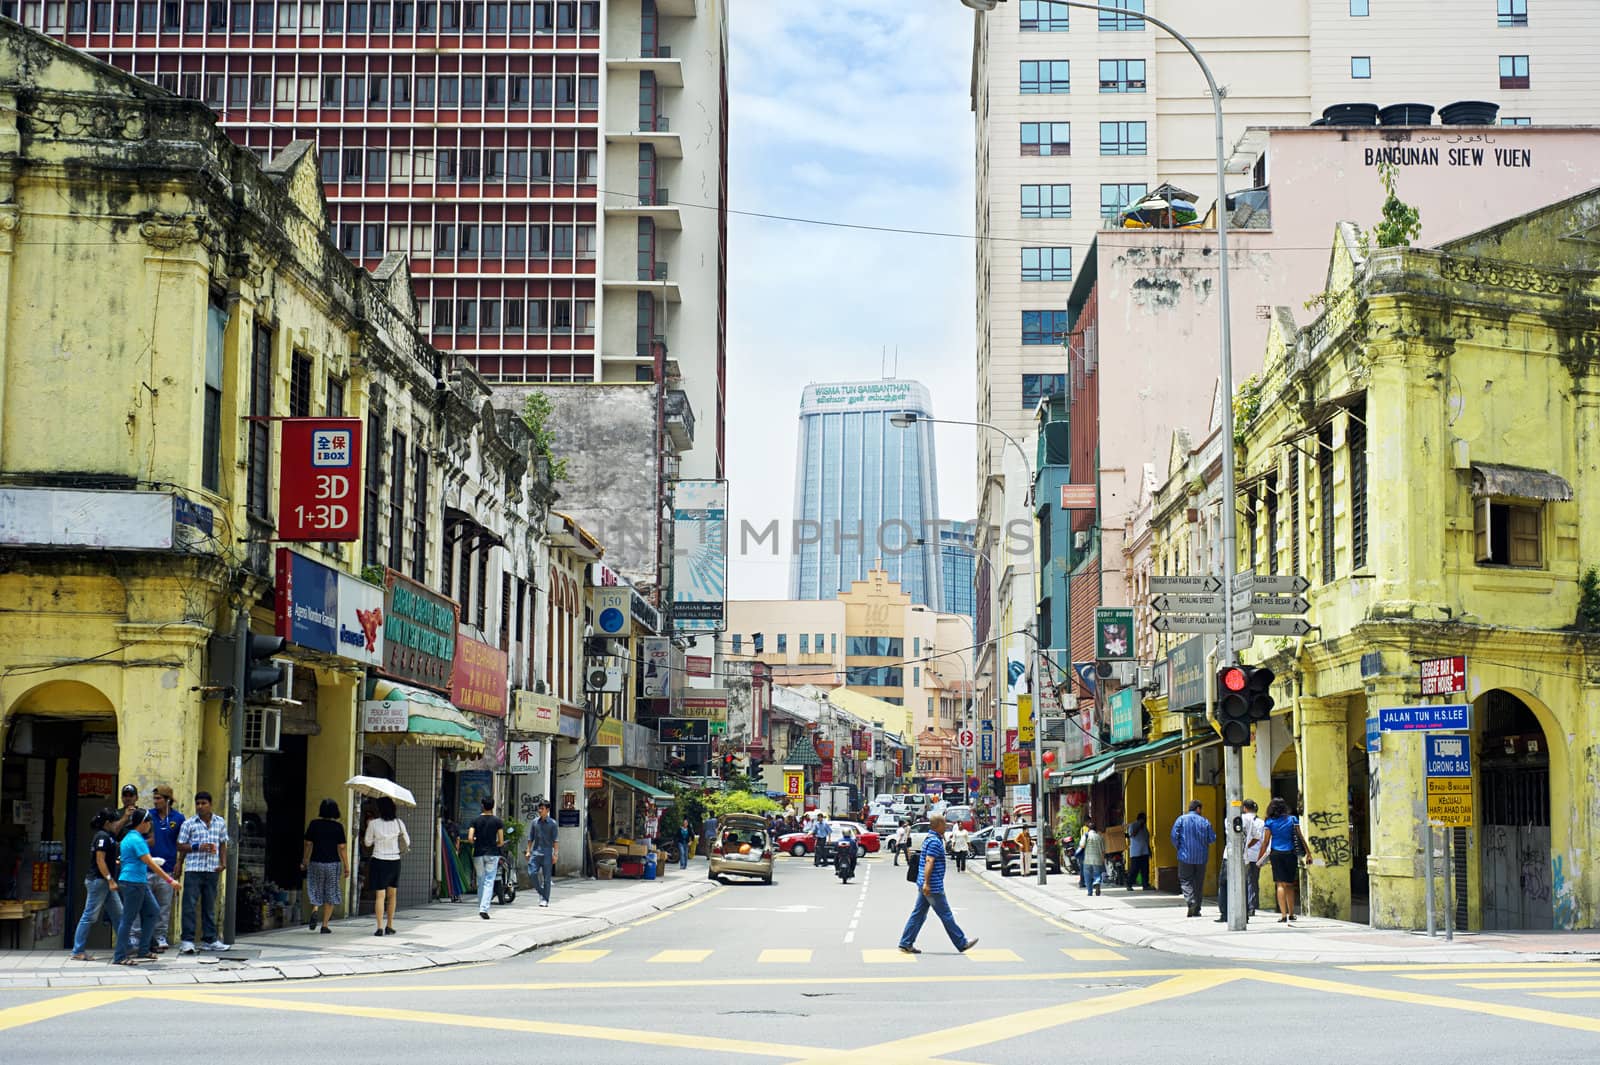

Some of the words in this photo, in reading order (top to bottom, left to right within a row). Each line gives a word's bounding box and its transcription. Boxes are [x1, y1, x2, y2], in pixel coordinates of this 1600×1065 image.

[1364, 147, 1439, 166] BANGUNAN
[1448, 148, 1484, 166] SIEW
[1495, 148, 1531, 167] YUEN
[815, 386, 840, 396] WISMA
[841, 385, 857, 394] TUN
[857, 383, 910, 394] SAMBANTHAN
[317, 436, 345, 450] 全保
[315, 475, 349, 499] 3D
[294, 505, 348, 529] 1+3D
[602, 597, 622, 607] 150
[1384, 712, 1410, 722] JALAN
[1415, 711, 1430, 721] TUN
[1428, 761, 1454, 772] LORONG
[1456, 760, 1469, 772] BAS
